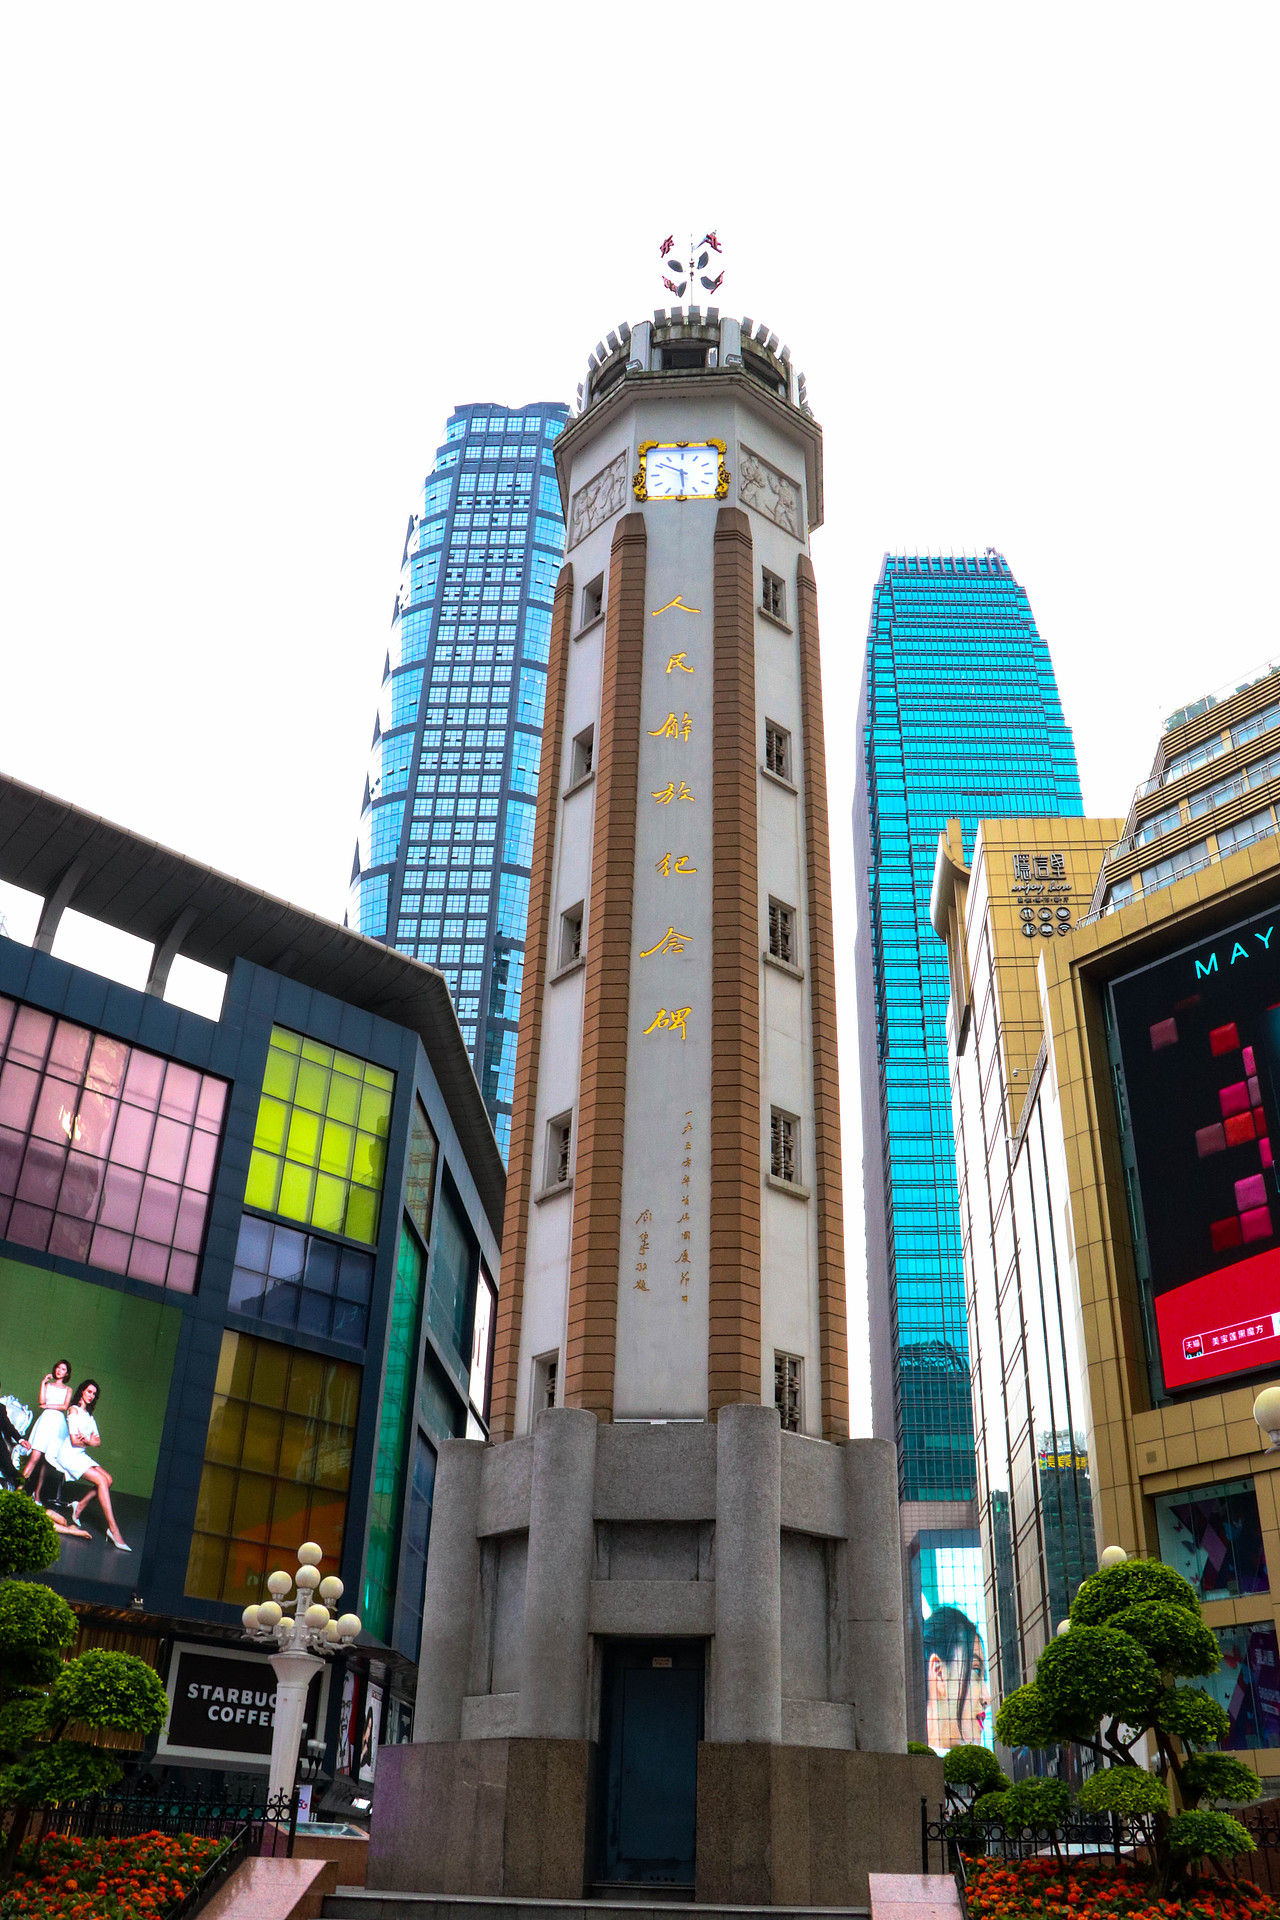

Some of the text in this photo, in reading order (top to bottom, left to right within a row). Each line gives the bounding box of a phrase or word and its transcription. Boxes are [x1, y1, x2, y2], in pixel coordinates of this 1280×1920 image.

[1012, 880, 1072, 895] enjoy here
[1194, 926, 1274, 979] MAY
